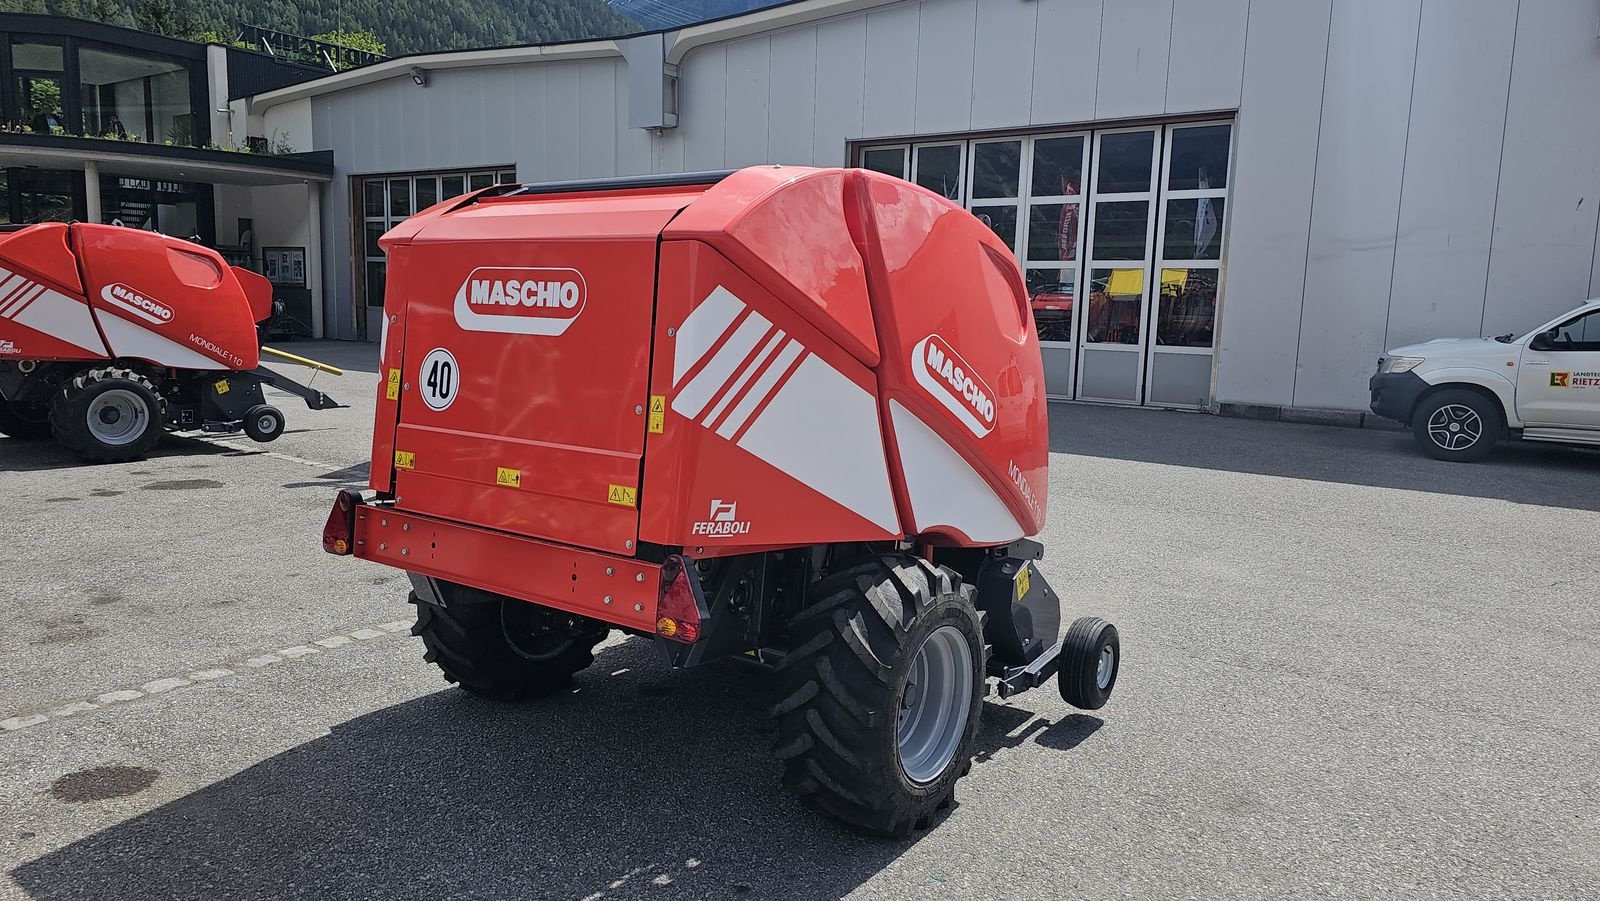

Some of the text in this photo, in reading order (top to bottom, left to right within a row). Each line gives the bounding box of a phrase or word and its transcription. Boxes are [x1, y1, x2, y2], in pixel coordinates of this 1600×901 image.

[113, 285, 171, 319] MASCHIO
[471, 279, 579, 308] MASCHIO
[189, 333, 243, 366] MONDIALE 110
[427, 360, 451, 399] 40
[927, 342, 994, 422] MASCHIO
[692, 521, 751, 535] FERABOLI
